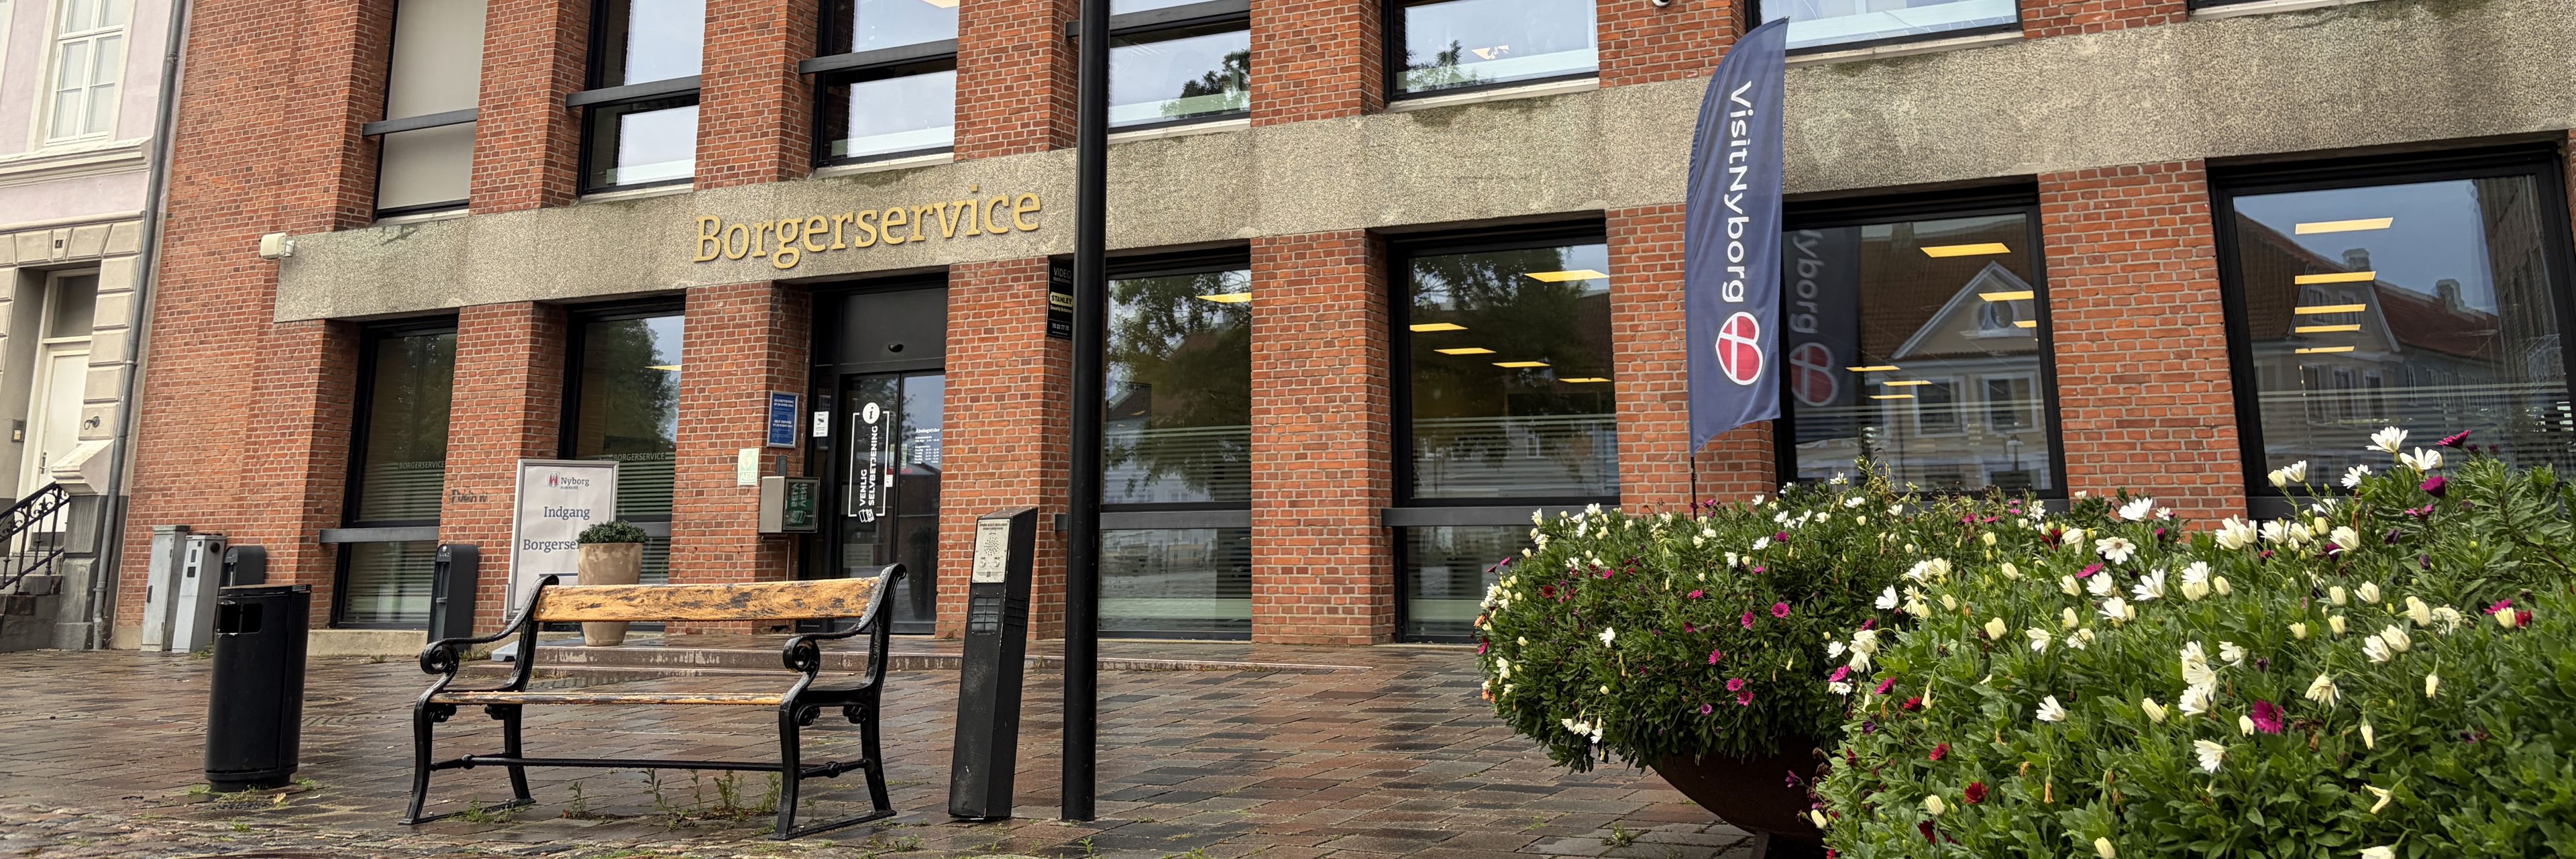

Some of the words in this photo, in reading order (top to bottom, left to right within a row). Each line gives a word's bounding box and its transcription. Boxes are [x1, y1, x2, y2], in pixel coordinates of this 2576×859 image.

[1722, 80, 1754, 303] VisitNyborg
[693, 184, 1041, 269] Borgerservice
[1053, 266, 1071, 279] VIDEO
[1051, 295, 1073, 304] STANLEY
[613, 452, 665, 462] BORGERSERVICE
[399, 460, 445, 469] BORGERSERVICE
[868, 425, 878, 505] SELVBETJENING
[561, 476, 590, 487] Nyborg
[859, 469, 867, 506] VENLIG
[544, 506, 590, 520] Indgang
